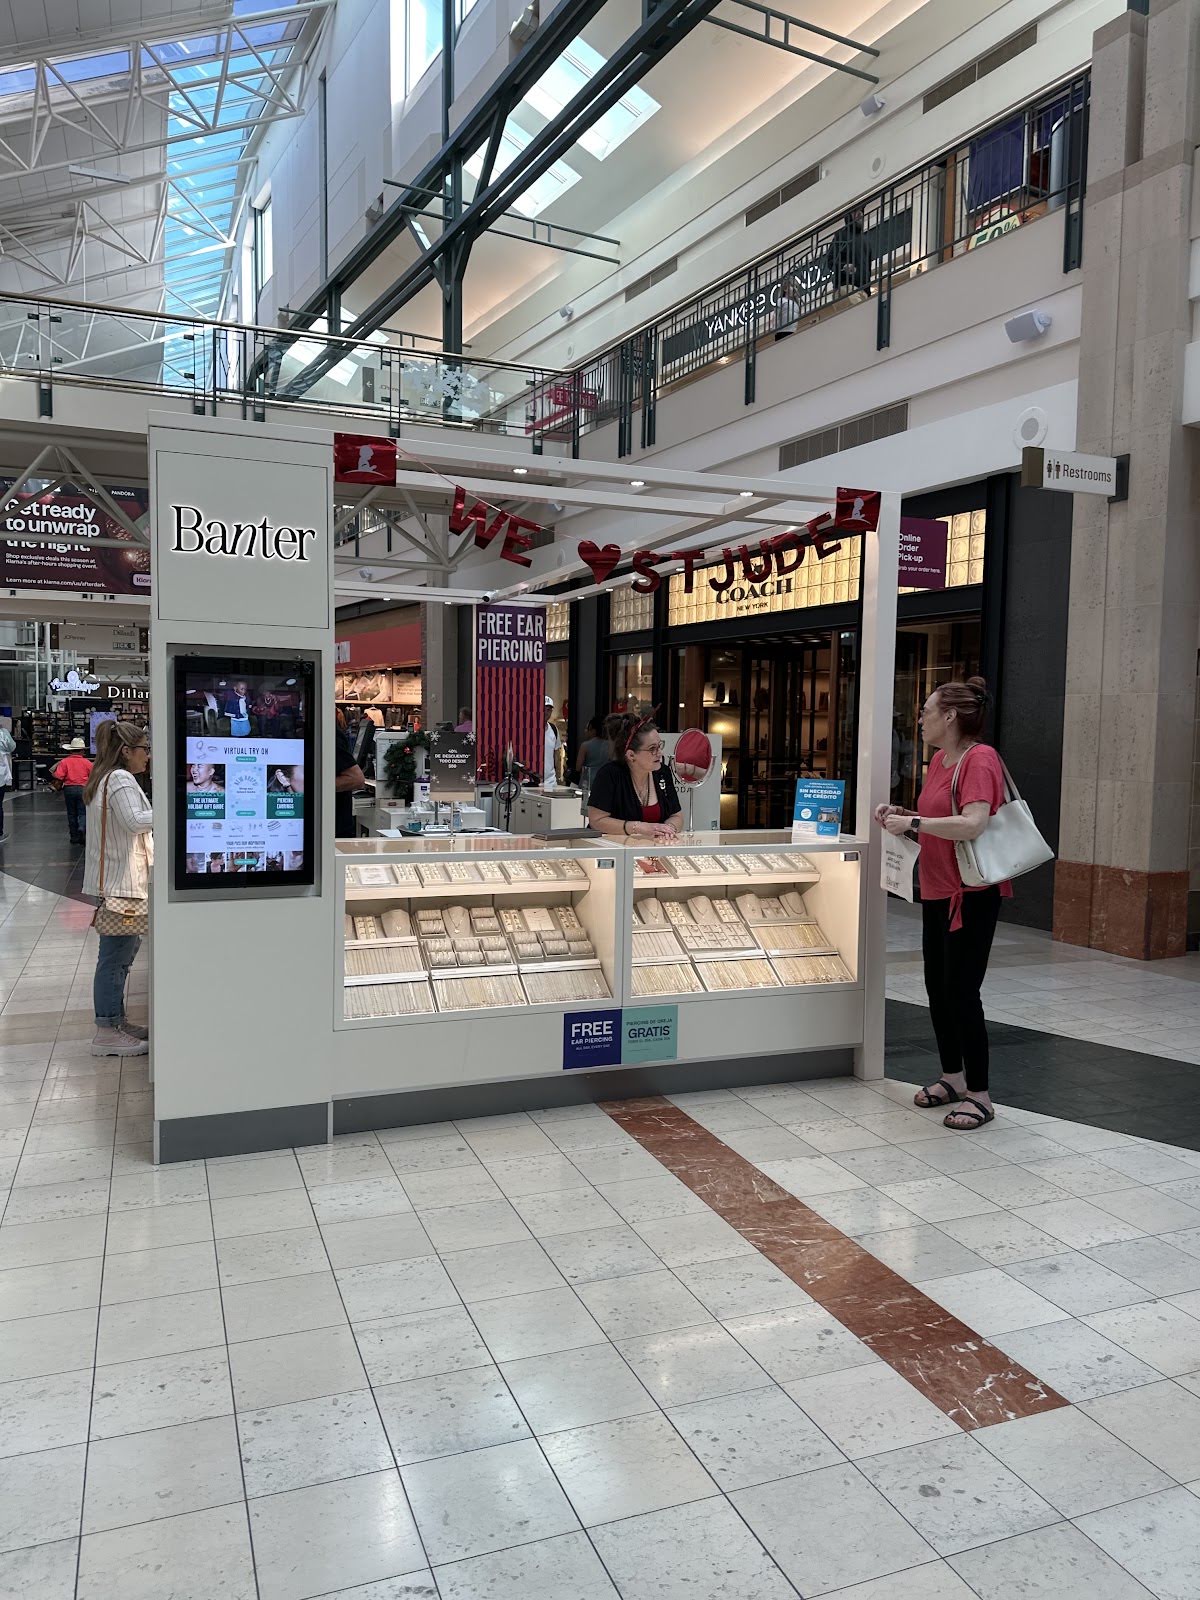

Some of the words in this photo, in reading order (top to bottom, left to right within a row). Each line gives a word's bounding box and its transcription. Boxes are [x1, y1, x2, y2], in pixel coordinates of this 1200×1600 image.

[1062, 463, 1112, 483] Restrooms
[42, 503, 96, 523] ready
[6, 518, 26, 531] to
[28, 520, 100, 538] unwrap
[170, 504, 316, 561] Banter
[449, 484, 543, 569] WE
[708, 511, 842, 592] JUDE
[898, 533, 922, 543] Online
[898, 543, 920, 552] Order
[5, 552, 20, 560] Shop
[898, 552, 924, 563] Pick-up
[57, 561, 82, 569] shopping
[716, 577, 793, 604] COACH
[737, 603, 751, 611] NEW
[752, 602, 769, 610] YORK
[478, 612, 512, 636] FREE
[517, 614, 543, 637] EAR
[107, 686, 150, 698] Dillar
[223, 747, 247, 755] VIRTUAL
[249, 747, 259, 755] TRY
[571, 1020, 614, 1038] FREE
[628, 1025, 671, 1039] GRATIS
[584, 1036, 613, 1044] PIERCING
